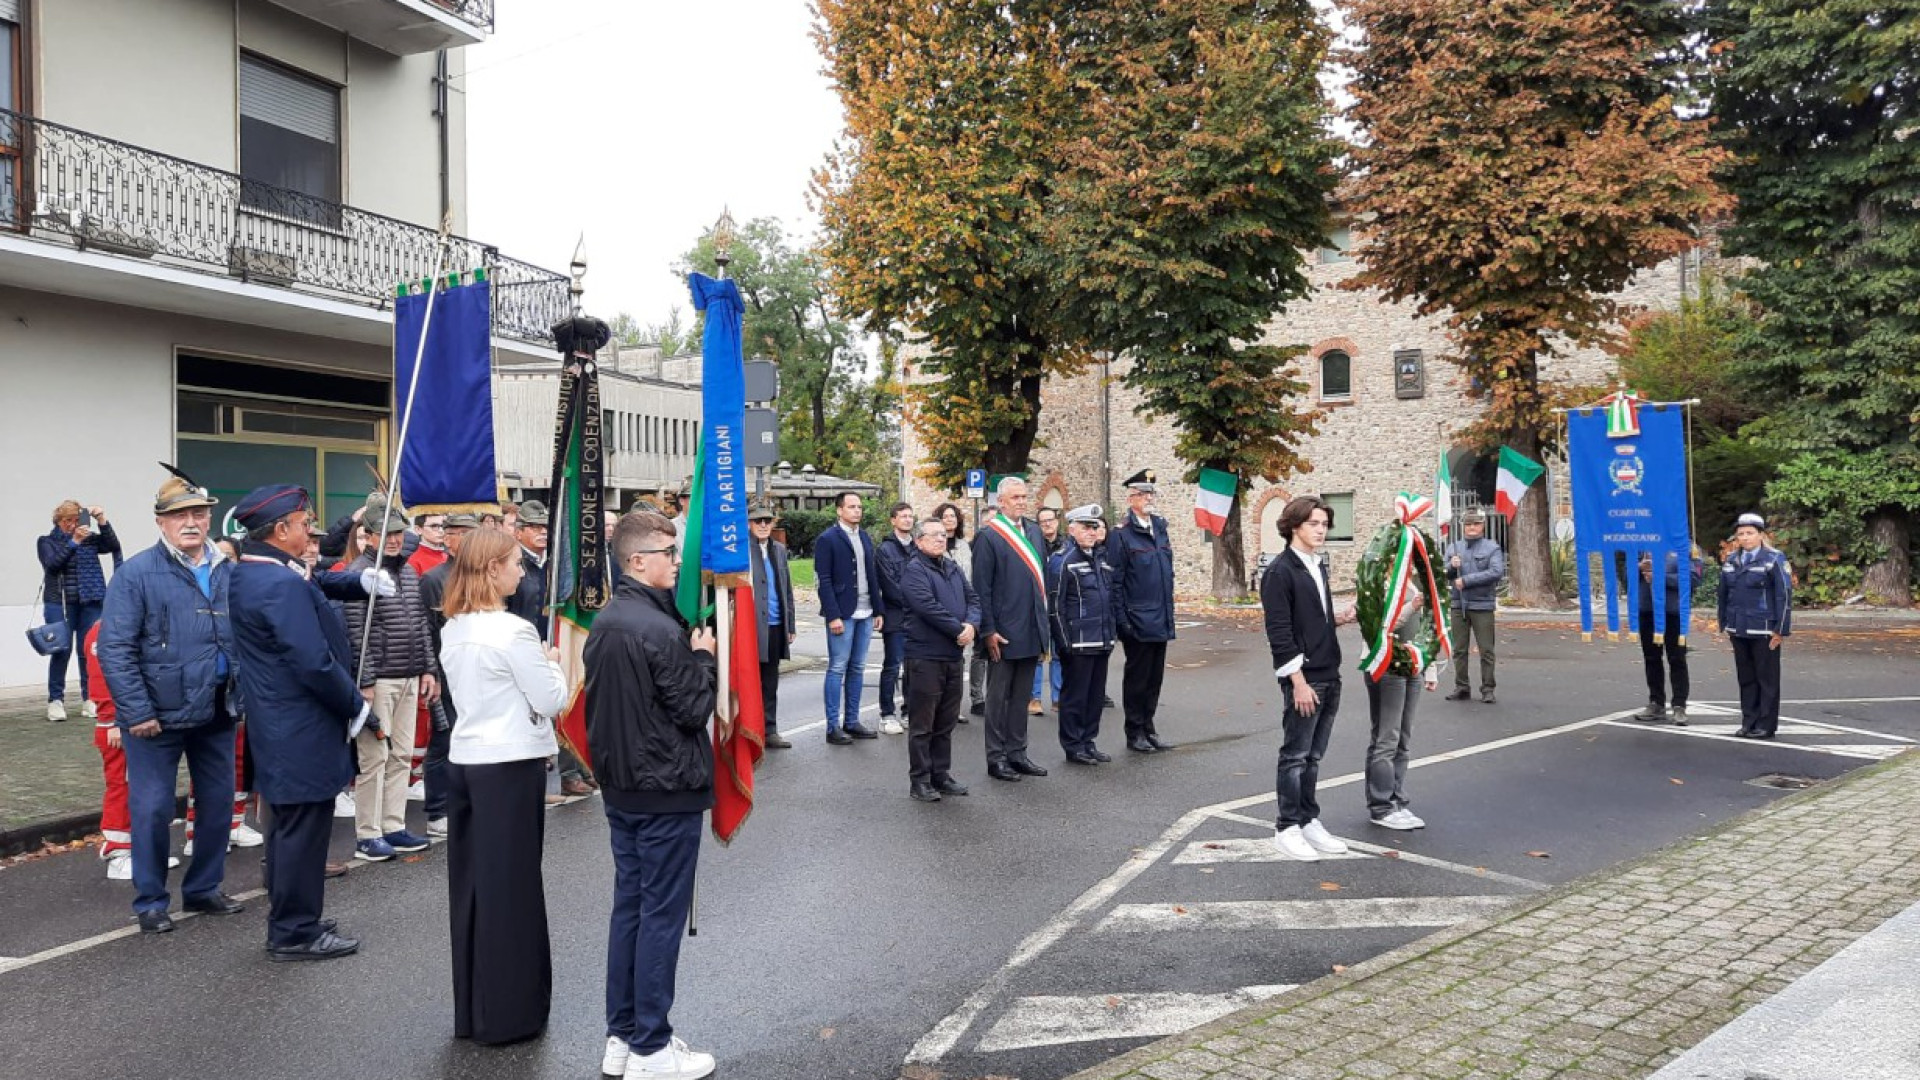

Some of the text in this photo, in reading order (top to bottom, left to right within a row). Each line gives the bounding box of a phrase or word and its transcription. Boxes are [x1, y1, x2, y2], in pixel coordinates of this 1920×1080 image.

[716, 425, 738, 553] ASS. PARTIGIANI
[970, 471, 981, 487] P
[582, 491, 597, 568] SEZIONE
